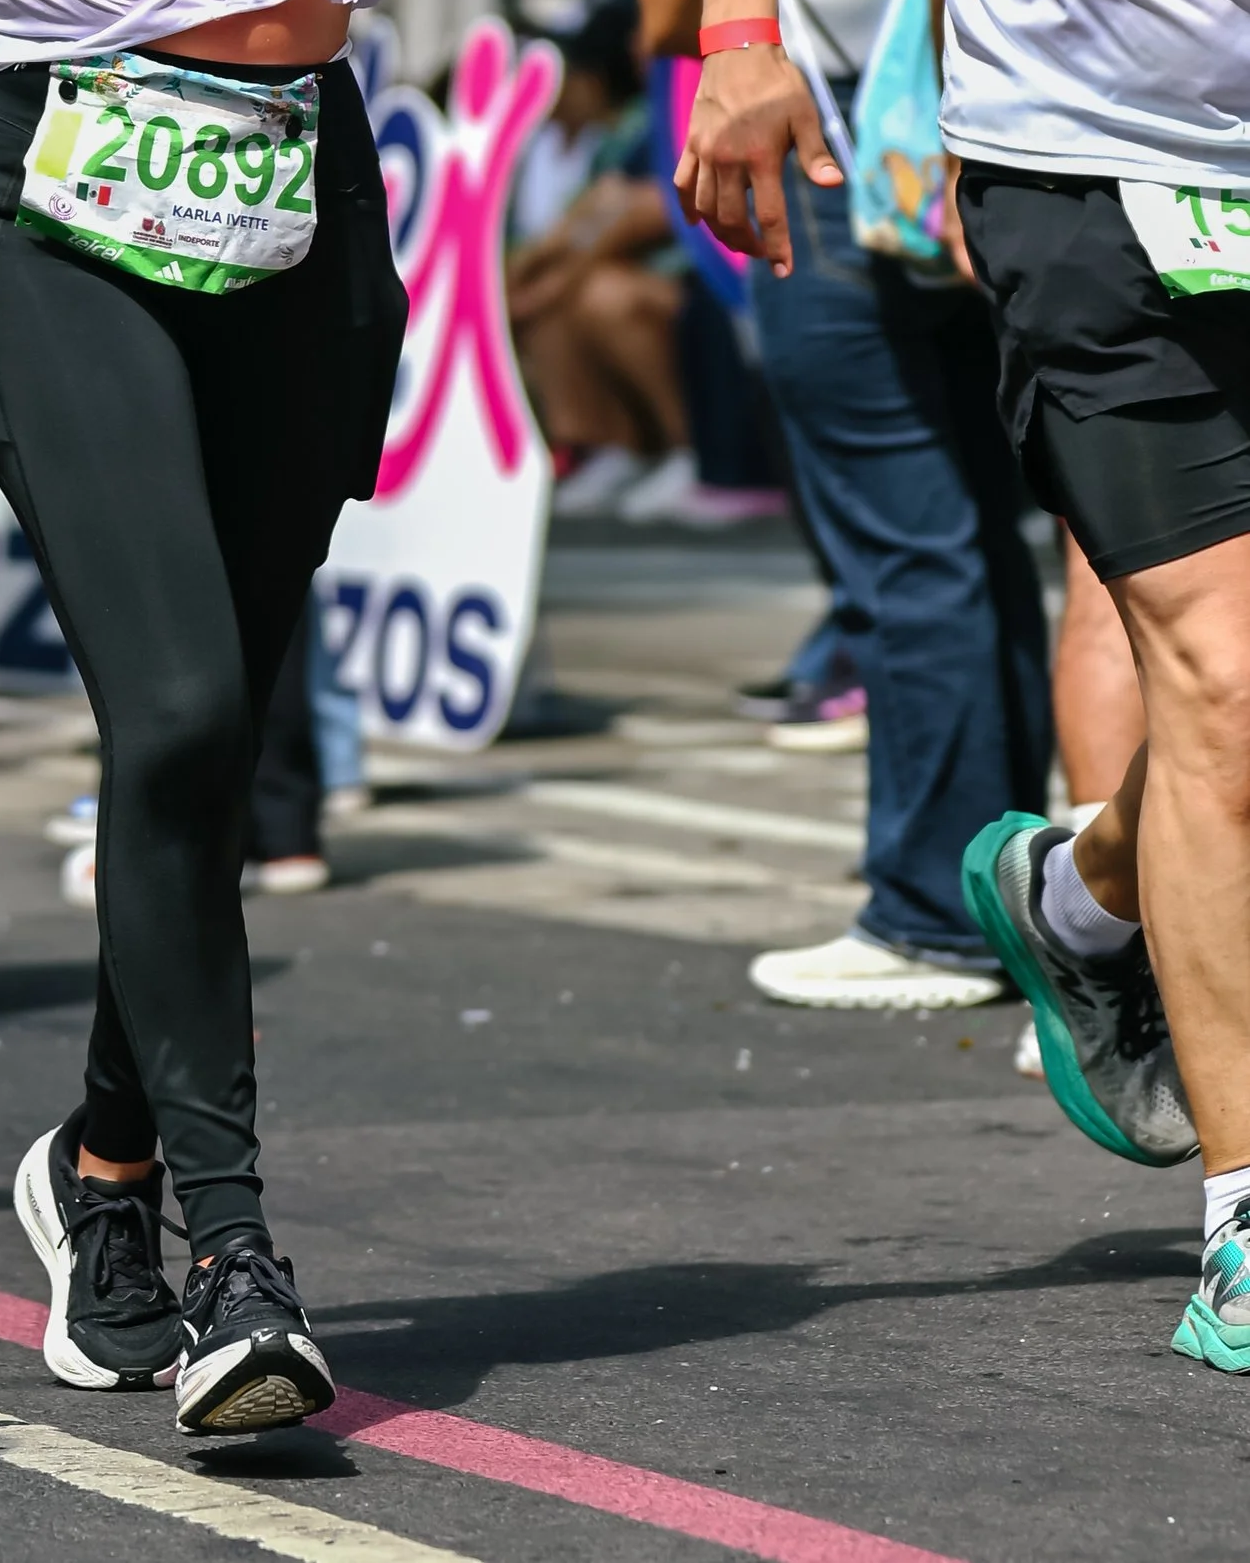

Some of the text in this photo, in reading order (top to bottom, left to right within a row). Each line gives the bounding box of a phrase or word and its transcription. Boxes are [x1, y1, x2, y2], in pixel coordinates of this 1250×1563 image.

[81, 106, 313, 214] 20892
[172, 205, 269, 231] KARLA IVETTE
[68, 233, 126, 262] telcel
[178, 234, 220, 248] INDEPORTE
